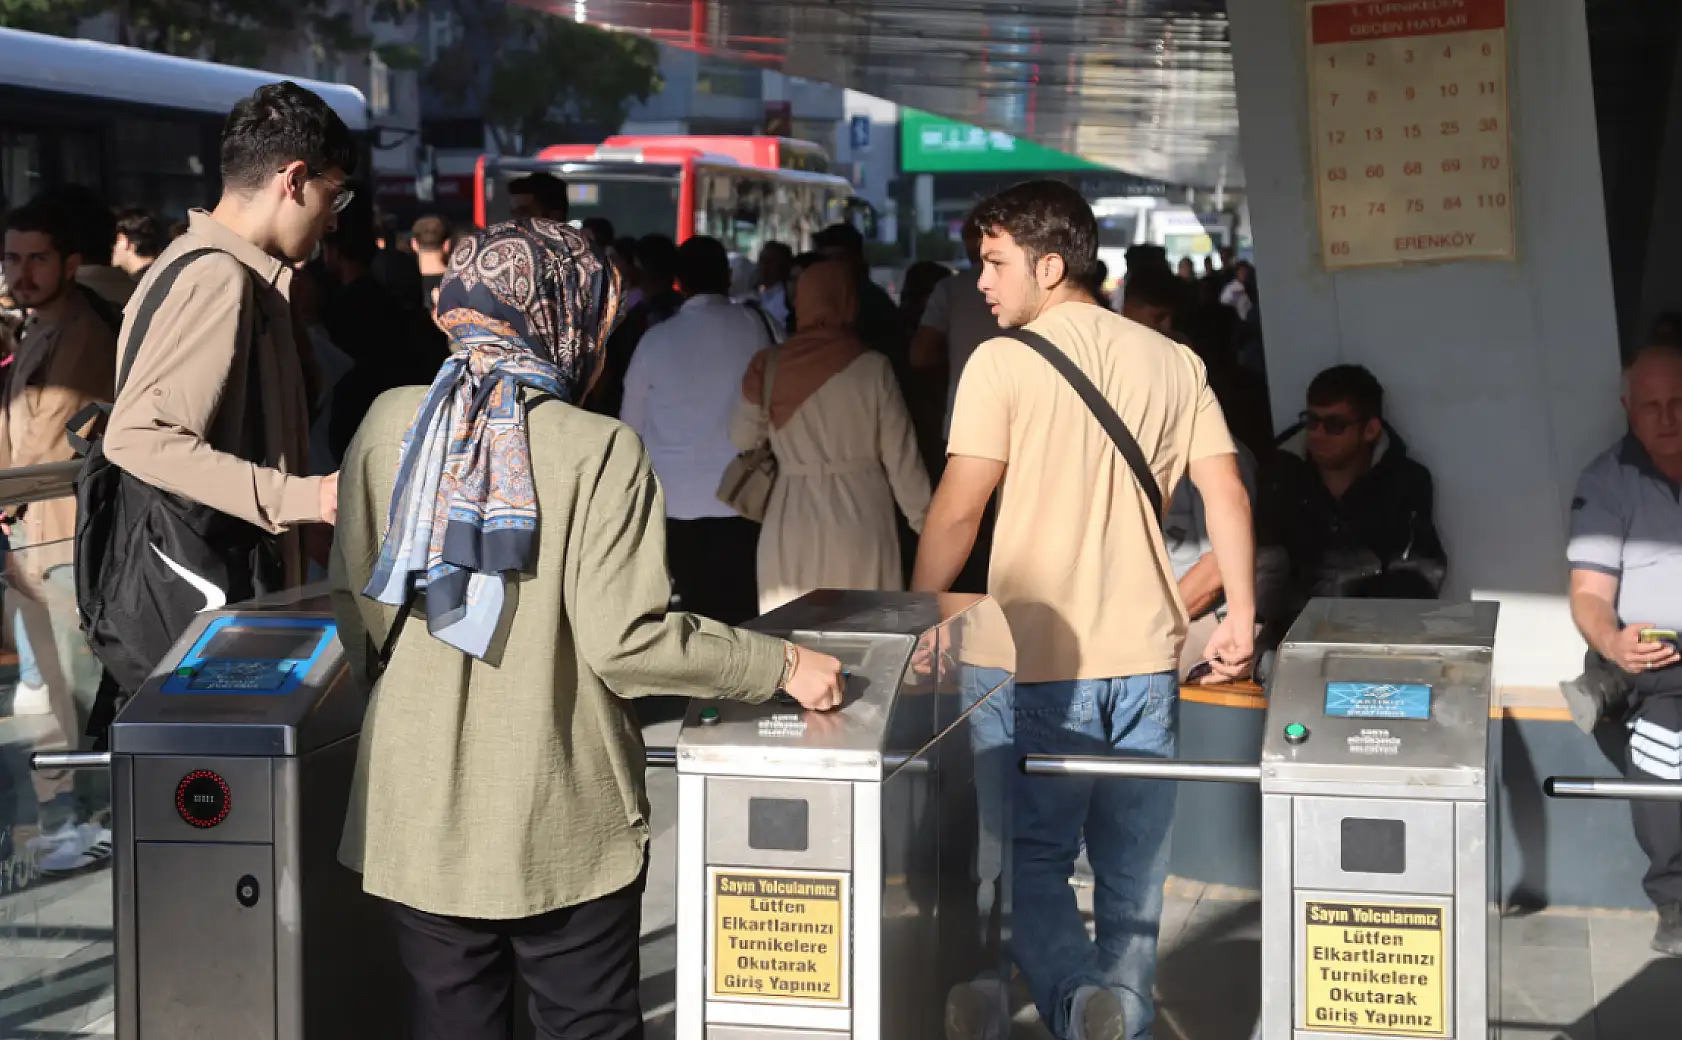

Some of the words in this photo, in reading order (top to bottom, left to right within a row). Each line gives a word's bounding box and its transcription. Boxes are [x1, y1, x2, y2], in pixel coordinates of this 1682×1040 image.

[1350, 20, 1404, 36] GEÇEN
[1407, 15, 1467, 31] HATLAR
[1329, 56, 1336, 68] 1
[1367, 53, 1376, 66] 2
[1405, 50, 1413, 63] 3
[1443, 46, 1452, 59] 4
[1331, 94, 1339, 106] 7
[1368, 91, 1377, 103] 8
[1406, 87, 1415, 100] 9
[1440, 84, 1458, 97] 10
[1479, 82, 1495, 94] 11
[1328, 131, 1345, 144] 12
[1366, 128, 1383, 140] 13
[1404, 125, 1421, 137] 15
[1441, 122, 1459, 135] 25
[1328, 168, 1347, 181] 63
[1366, 165, 1384, 178] 66
[1403, 162, 1421, 176] 68
[1442, 159, 1460, 172] 69
[1482, 156, 1500, 169] 70
[1331, 205, 1347, 219] 71
[1368, 202, 1386, 215] 74
[1407, 199, 1424, 212] 75
[1478, 193, 1506, 208] 110
[1331, 242, 1350, 255] 65
[1395, 232, 1476, 250] ERENKÖY
[720, 877, 755, 893] Sayın
[758, 879, 837, 897] Yolcularımız
[750, 898, 806, 914] Lütfen
[1311, 905, 1349, 923] Sayın
[1352, 907, 1438, 926] Yolcularımız
[721, 916, 834, 935] Elkartlarınızı
[728, 936, 828, 954] Turnikelere
[1343, 930, 1404, 947] Lütfen
[737, 956, 817, 973] Okutarak
[1313, 945, 1435, 966] Elkartlarınızı
[724, 975, 764, 992] Giriş
[769, 976, 831, 993] Yapınız
[1320, 967, 1428, 985] Turnikelere
[1329, 987, 1418, 1006] Okutarak
[1315, 1007, 1359, 1025] Giriş
[1365, 1009, 1433, 1027] Yapınız
